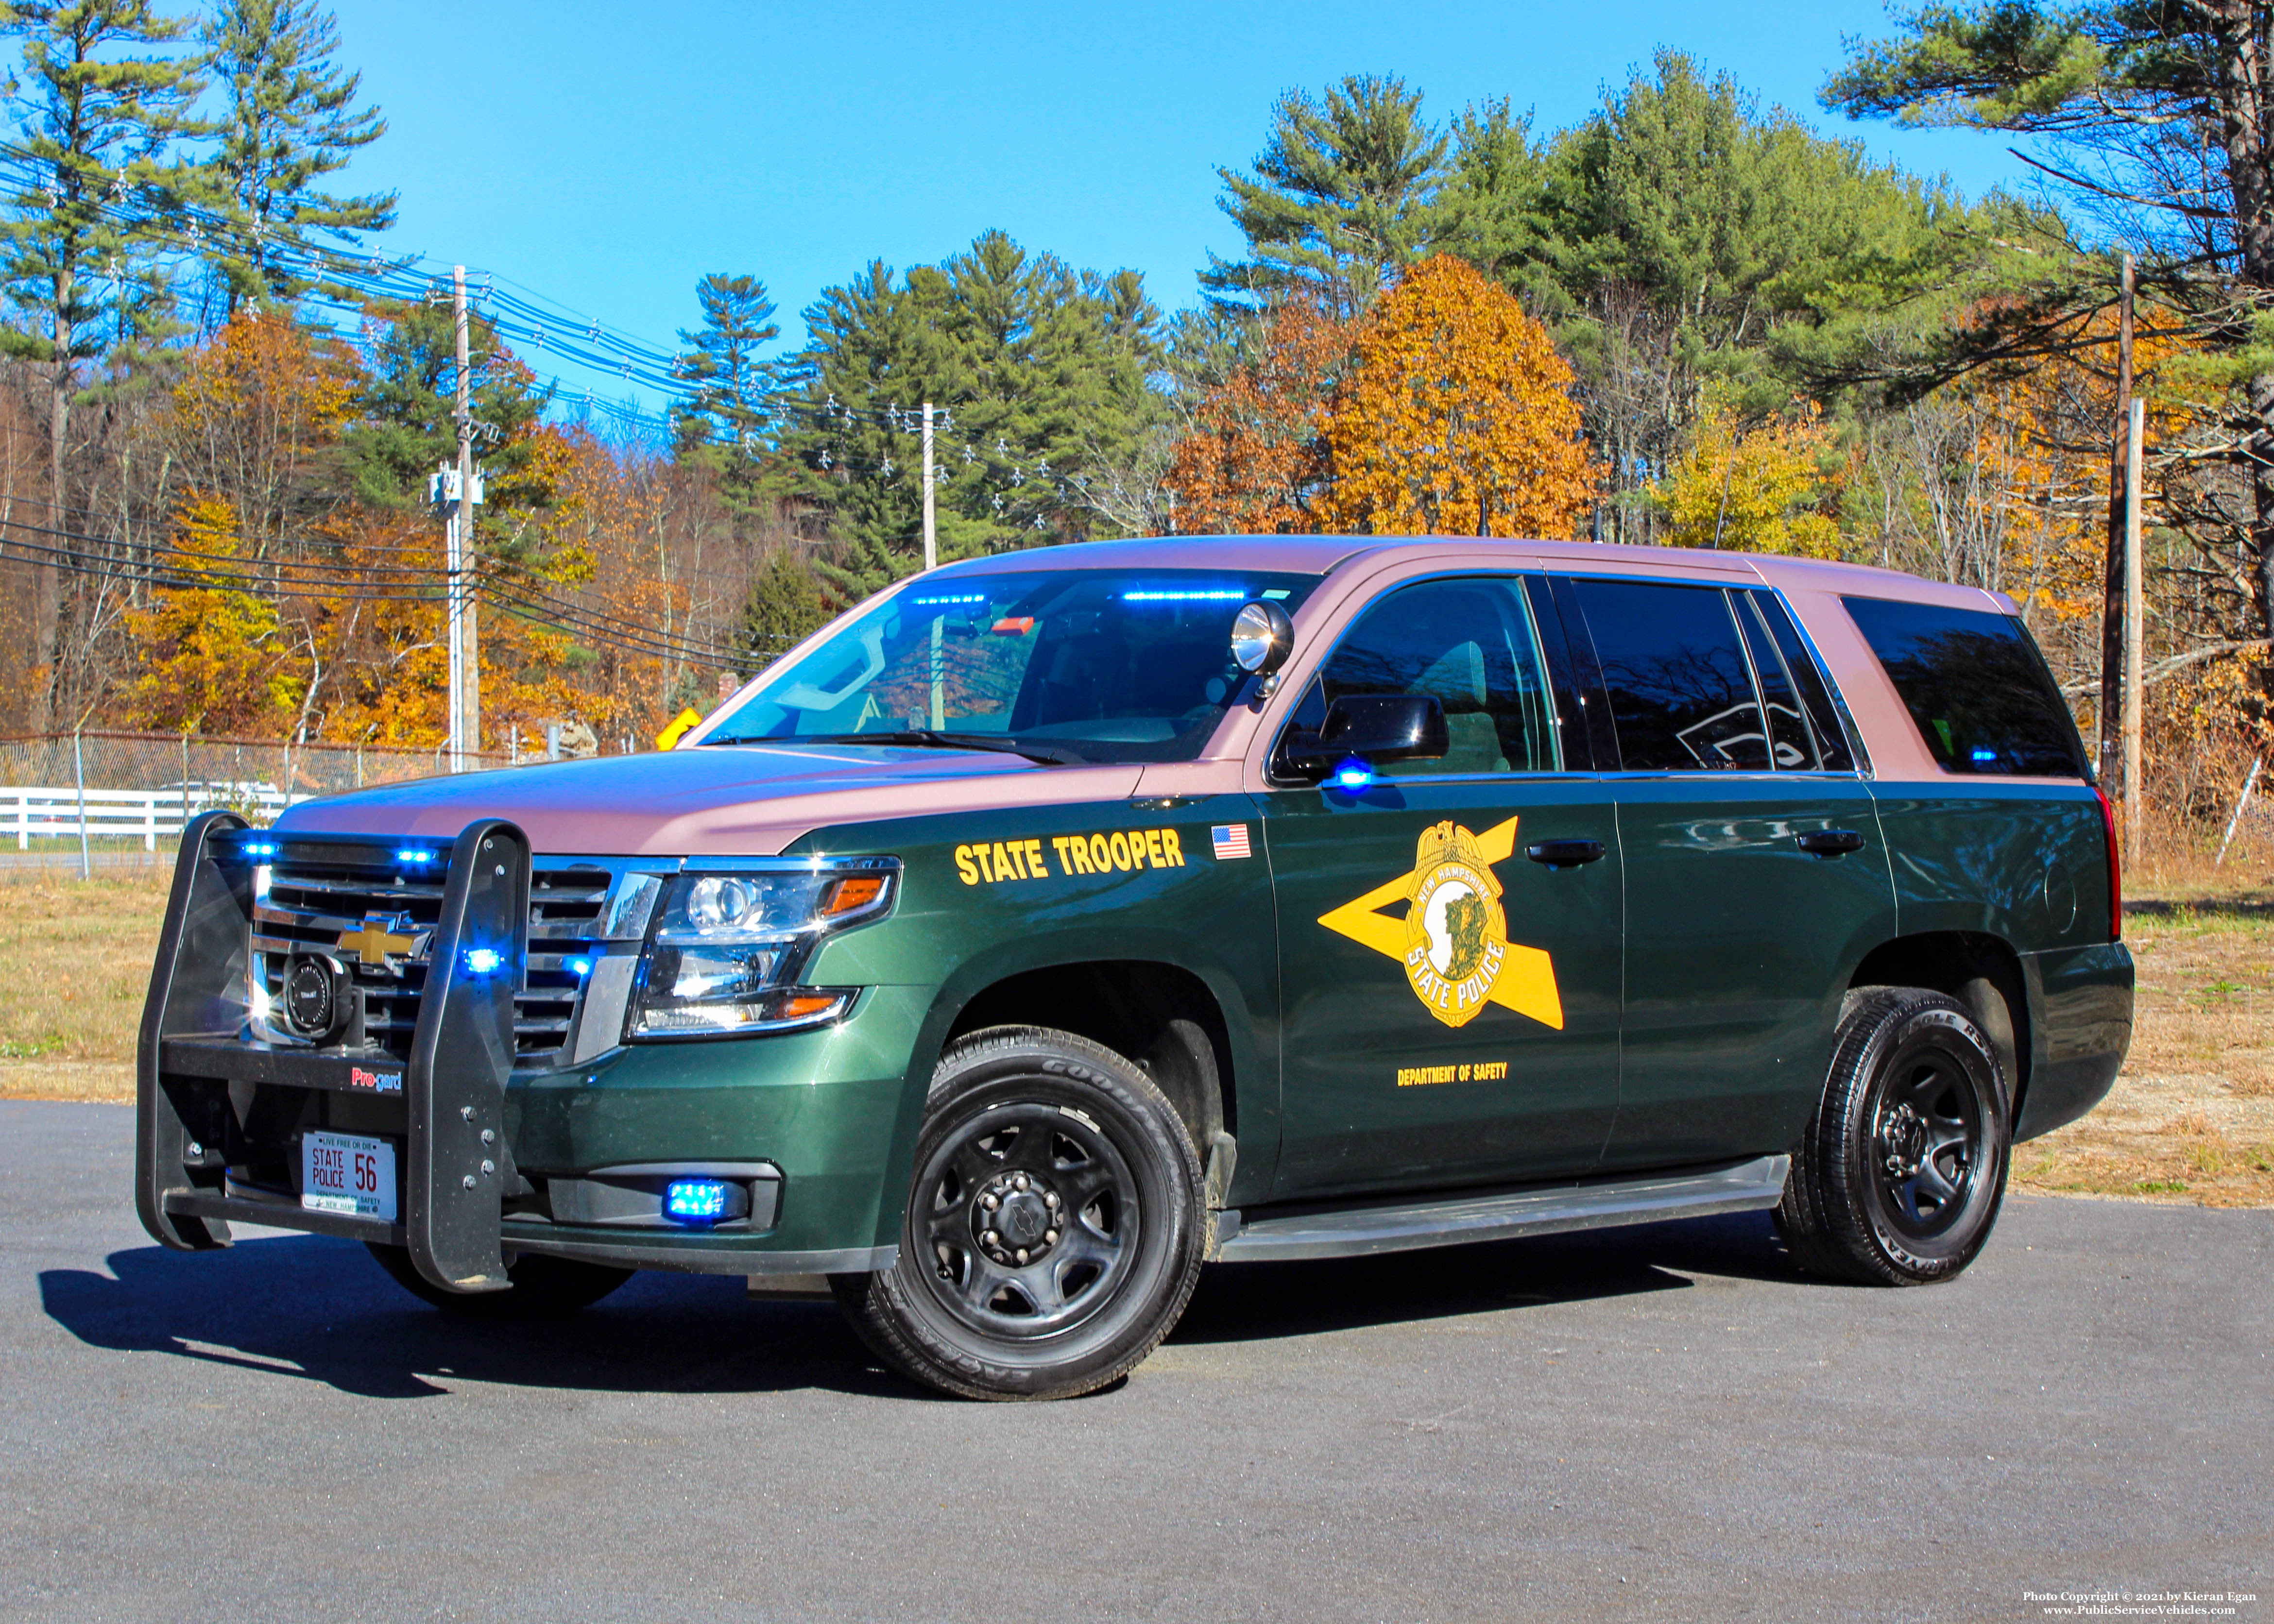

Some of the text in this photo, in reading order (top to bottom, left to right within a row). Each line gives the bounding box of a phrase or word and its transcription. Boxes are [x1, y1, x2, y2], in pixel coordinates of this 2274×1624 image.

[954, 828, 1185, 886] STATE TROOPER
[1419, 866, 1490, 903] NEW HAMPSHIRE
[1407, 941, 1505, 1009] STATE POLICE
[1397, 1062, 1507, 1087] DEPARTMENT OF SAFETY
[313, 1148, 343, 1169] STATE
[313, 1167, 344, 1189] POLICE
[355, 1153, 376, 1193] 56
[316, 1190, 348, 1200] DEPARTMENT
[361, 1197, 380, 1205] SAFETY
[326, 1200, 338, 1209] NEW
